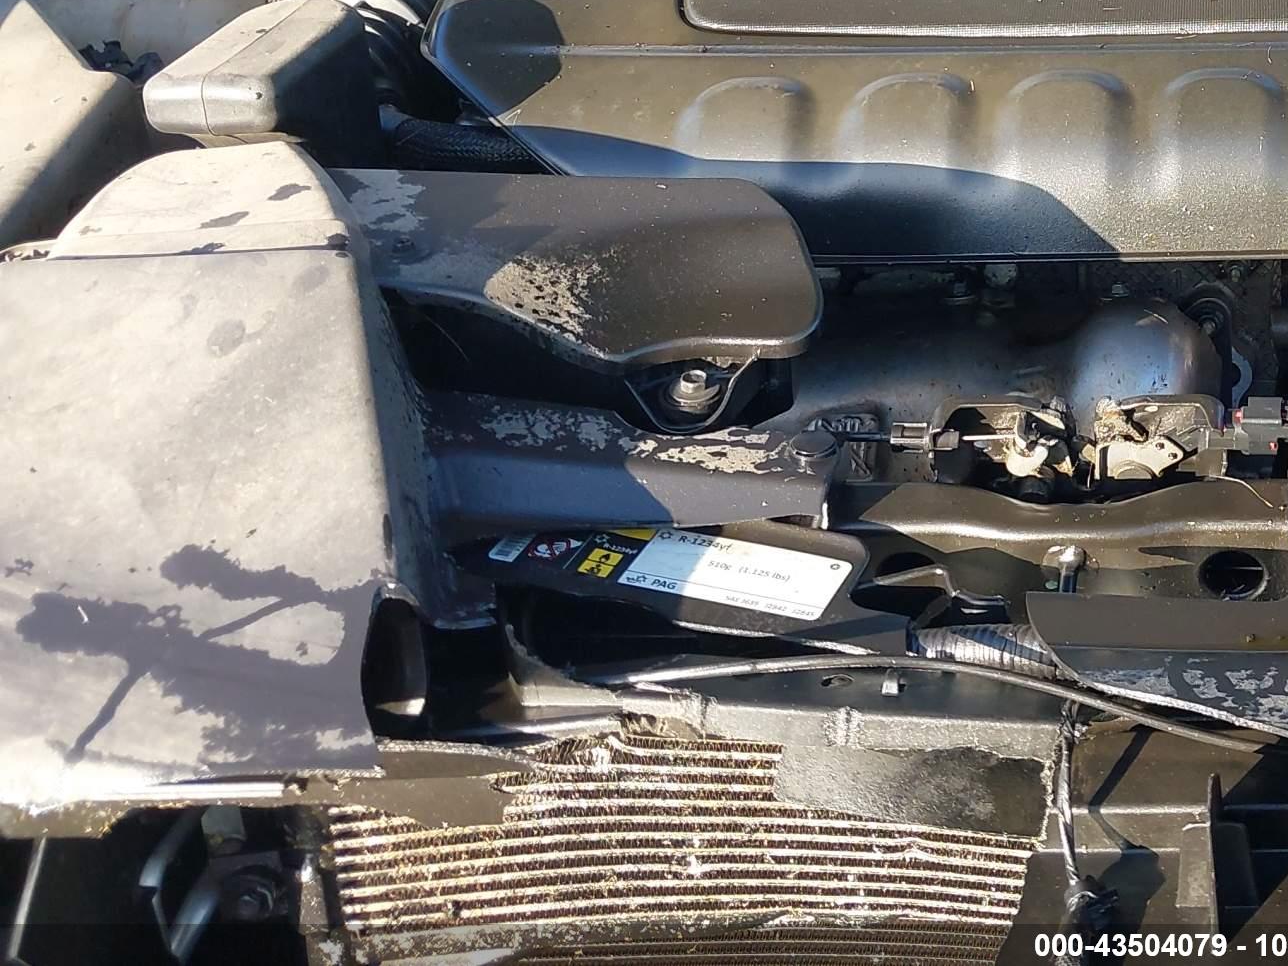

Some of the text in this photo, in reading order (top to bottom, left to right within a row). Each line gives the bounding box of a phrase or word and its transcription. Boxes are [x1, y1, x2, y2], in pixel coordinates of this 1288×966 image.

[678, 534, 734, 555] R-1234yf
[771, 569, 791, 583] lbs)
[651, 578, 678, 591] PAG
